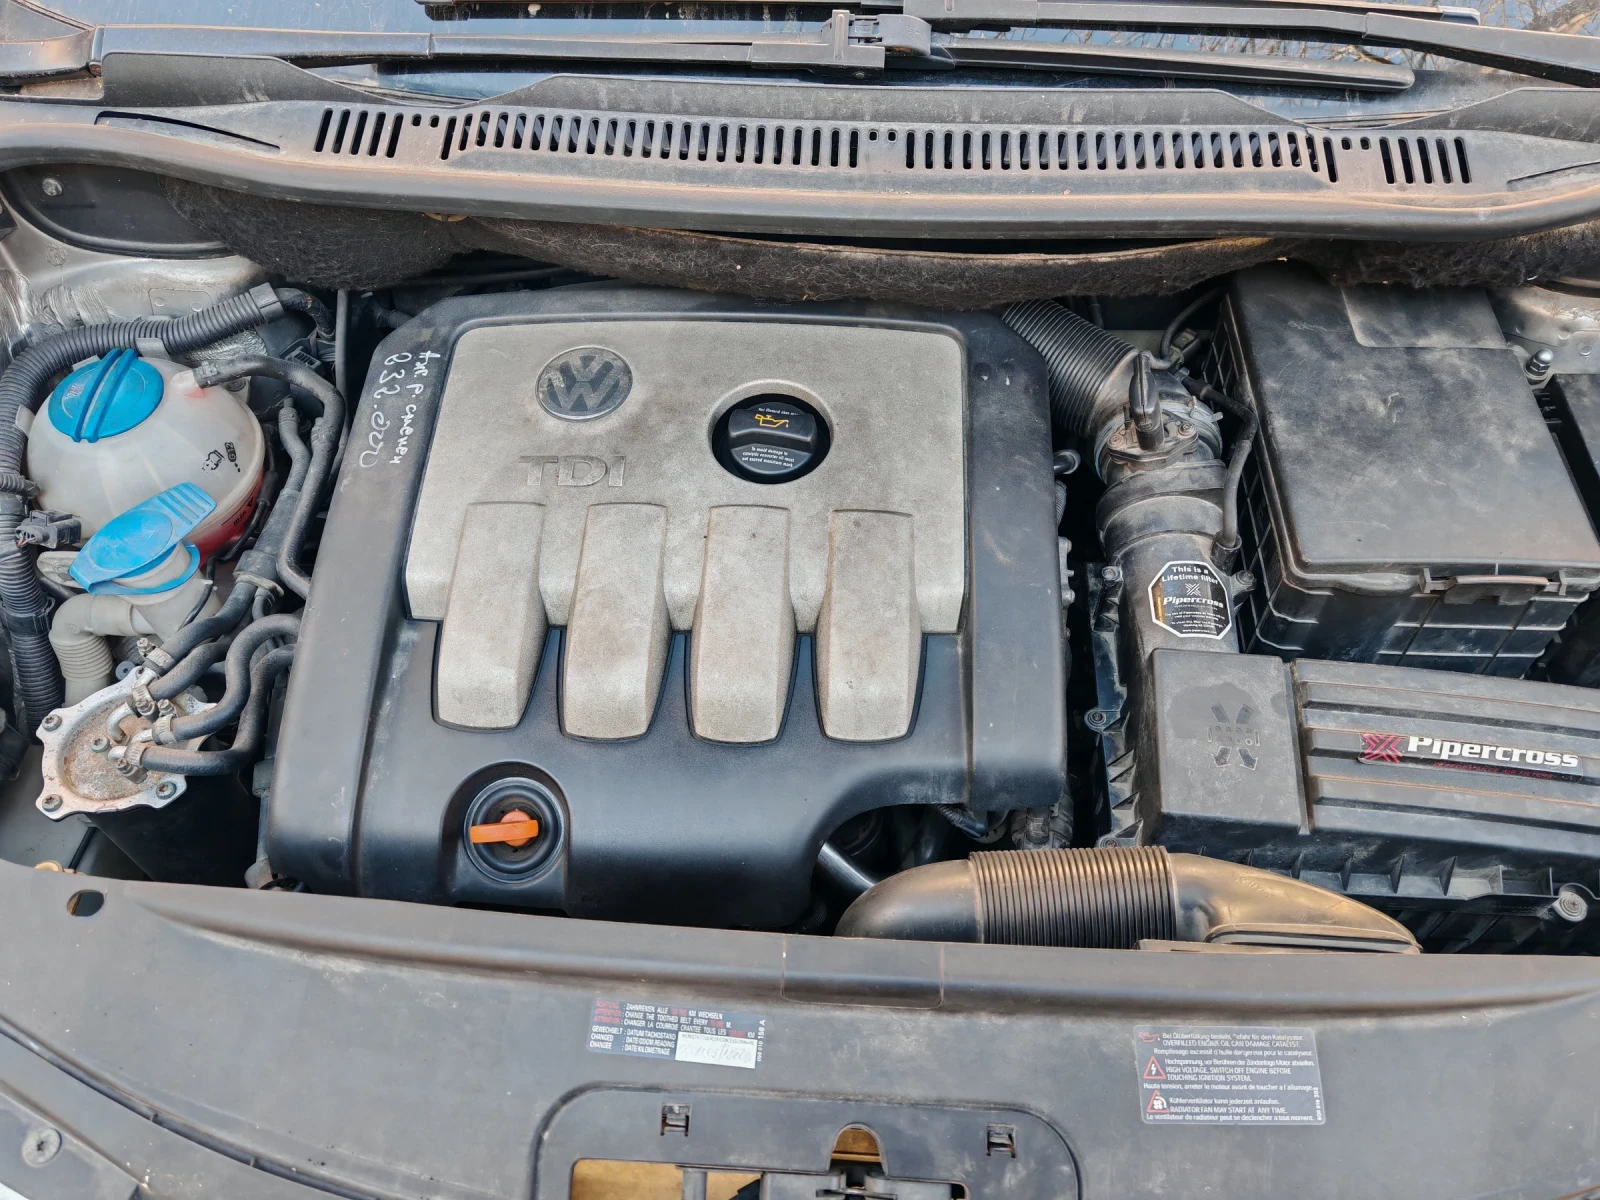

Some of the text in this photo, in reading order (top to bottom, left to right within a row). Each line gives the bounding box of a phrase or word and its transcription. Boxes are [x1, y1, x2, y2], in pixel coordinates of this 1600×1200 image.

[225, 442, 236, 461] G12
[518, 456, 626, 487] TDI
[234, 510, 246, 526] min
[1162, 574, 1218, 584] Lifetime filter
[1163, 596, 1224, 608] Pipercross
[1408, 736, 1579, 768] Pipercross
[657, 1014, 678, 1022] TOOTHED
[698, 1011, 723, 1020] WECHSELN
[624, 1019, 645, 1027] CHANGER
[592, 1025, 623, 1034] GEWECHSELT
[591, 1033, 614, 1041] CHANGED
[590, 1040, 612, 1049] CHANGEE
[1154, 1048, 1189, 1056] Remplissage
